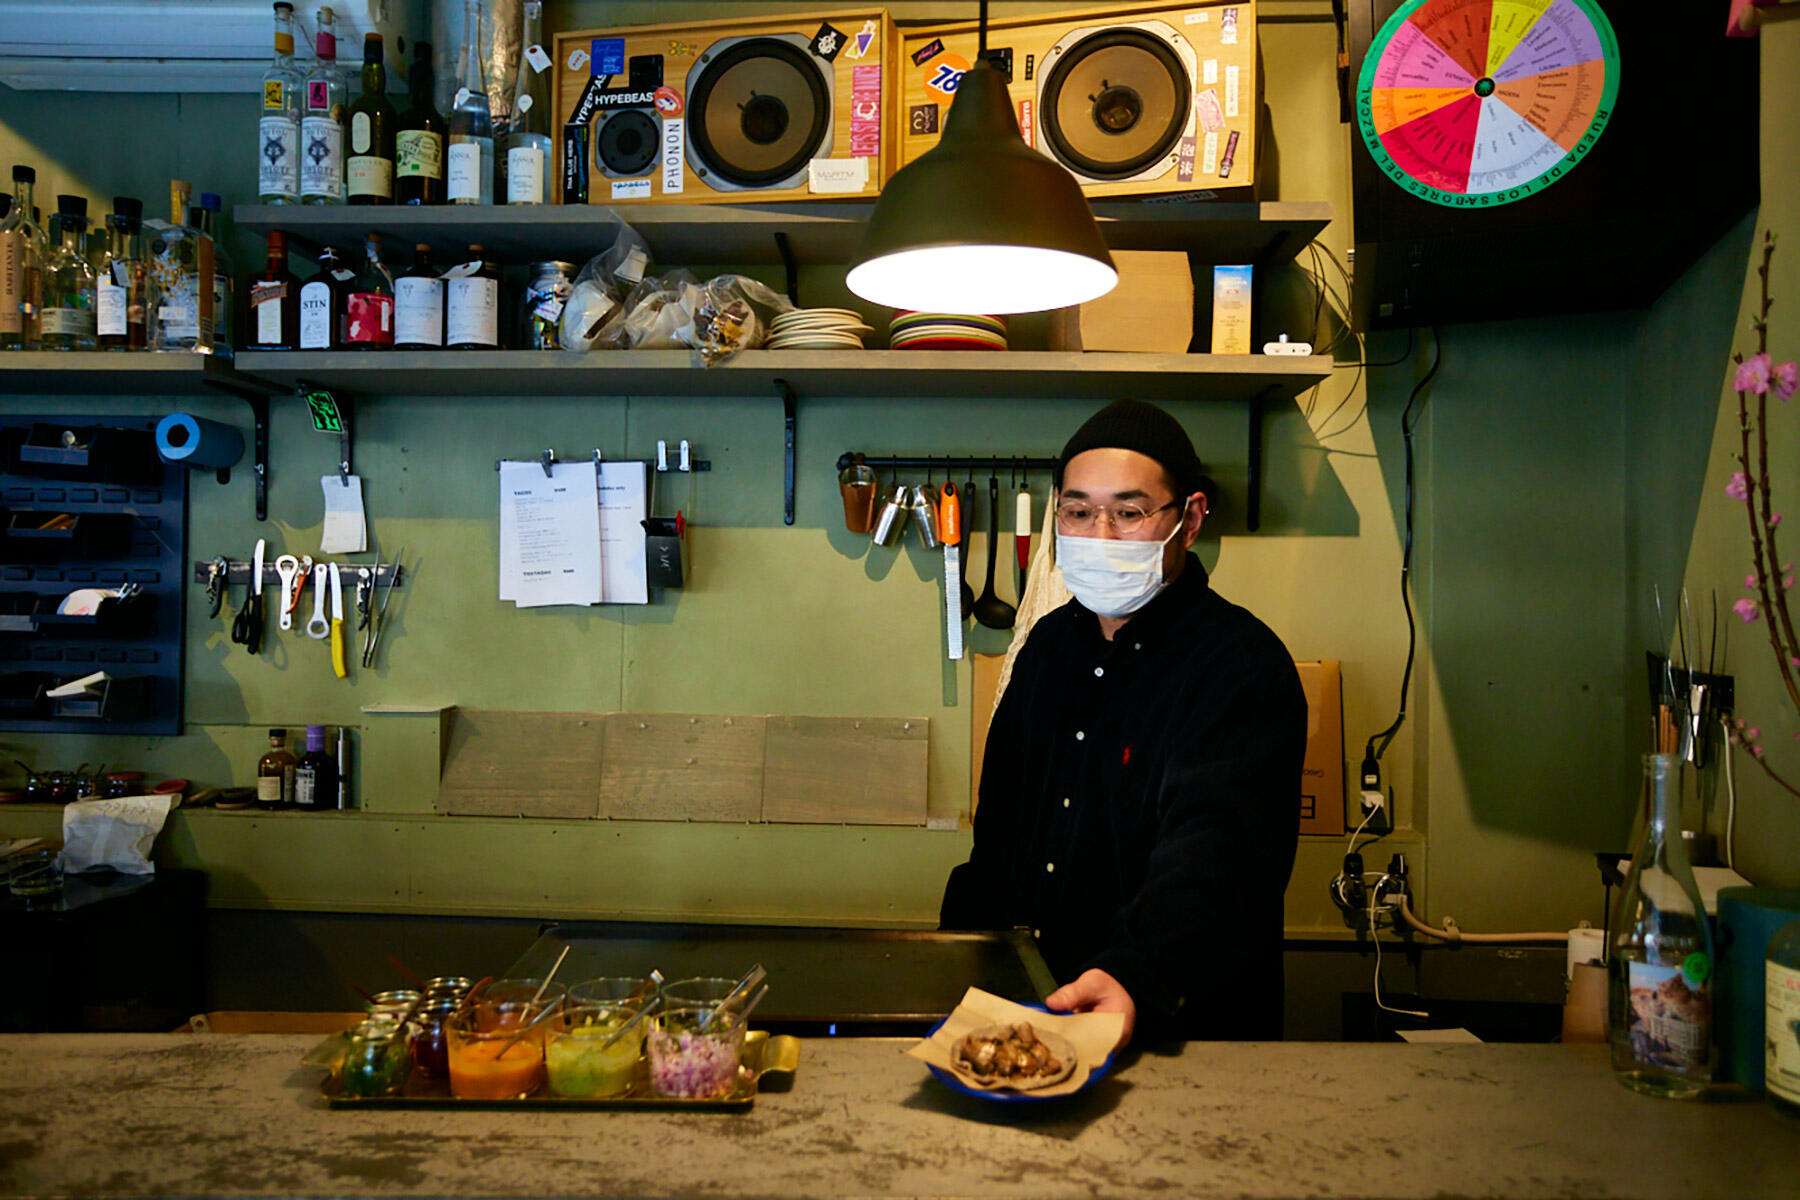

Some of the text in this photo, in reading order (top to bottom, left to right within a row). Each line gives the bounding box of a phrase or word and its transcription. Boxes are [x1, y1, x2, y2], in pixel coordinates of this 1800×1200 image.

[595, 91, 657, 105] HYPEBEAS
[1357, 85, 1381, 150] MEZCAL
[1567, 109, 1608, 163] RUEDA
[667, 123, 680, 188] PHONON
[1381, 153, 1404, 181] DEL
[1539, 167, 1562, 185] DE
[1498, 185, 1532, 203] LOS
